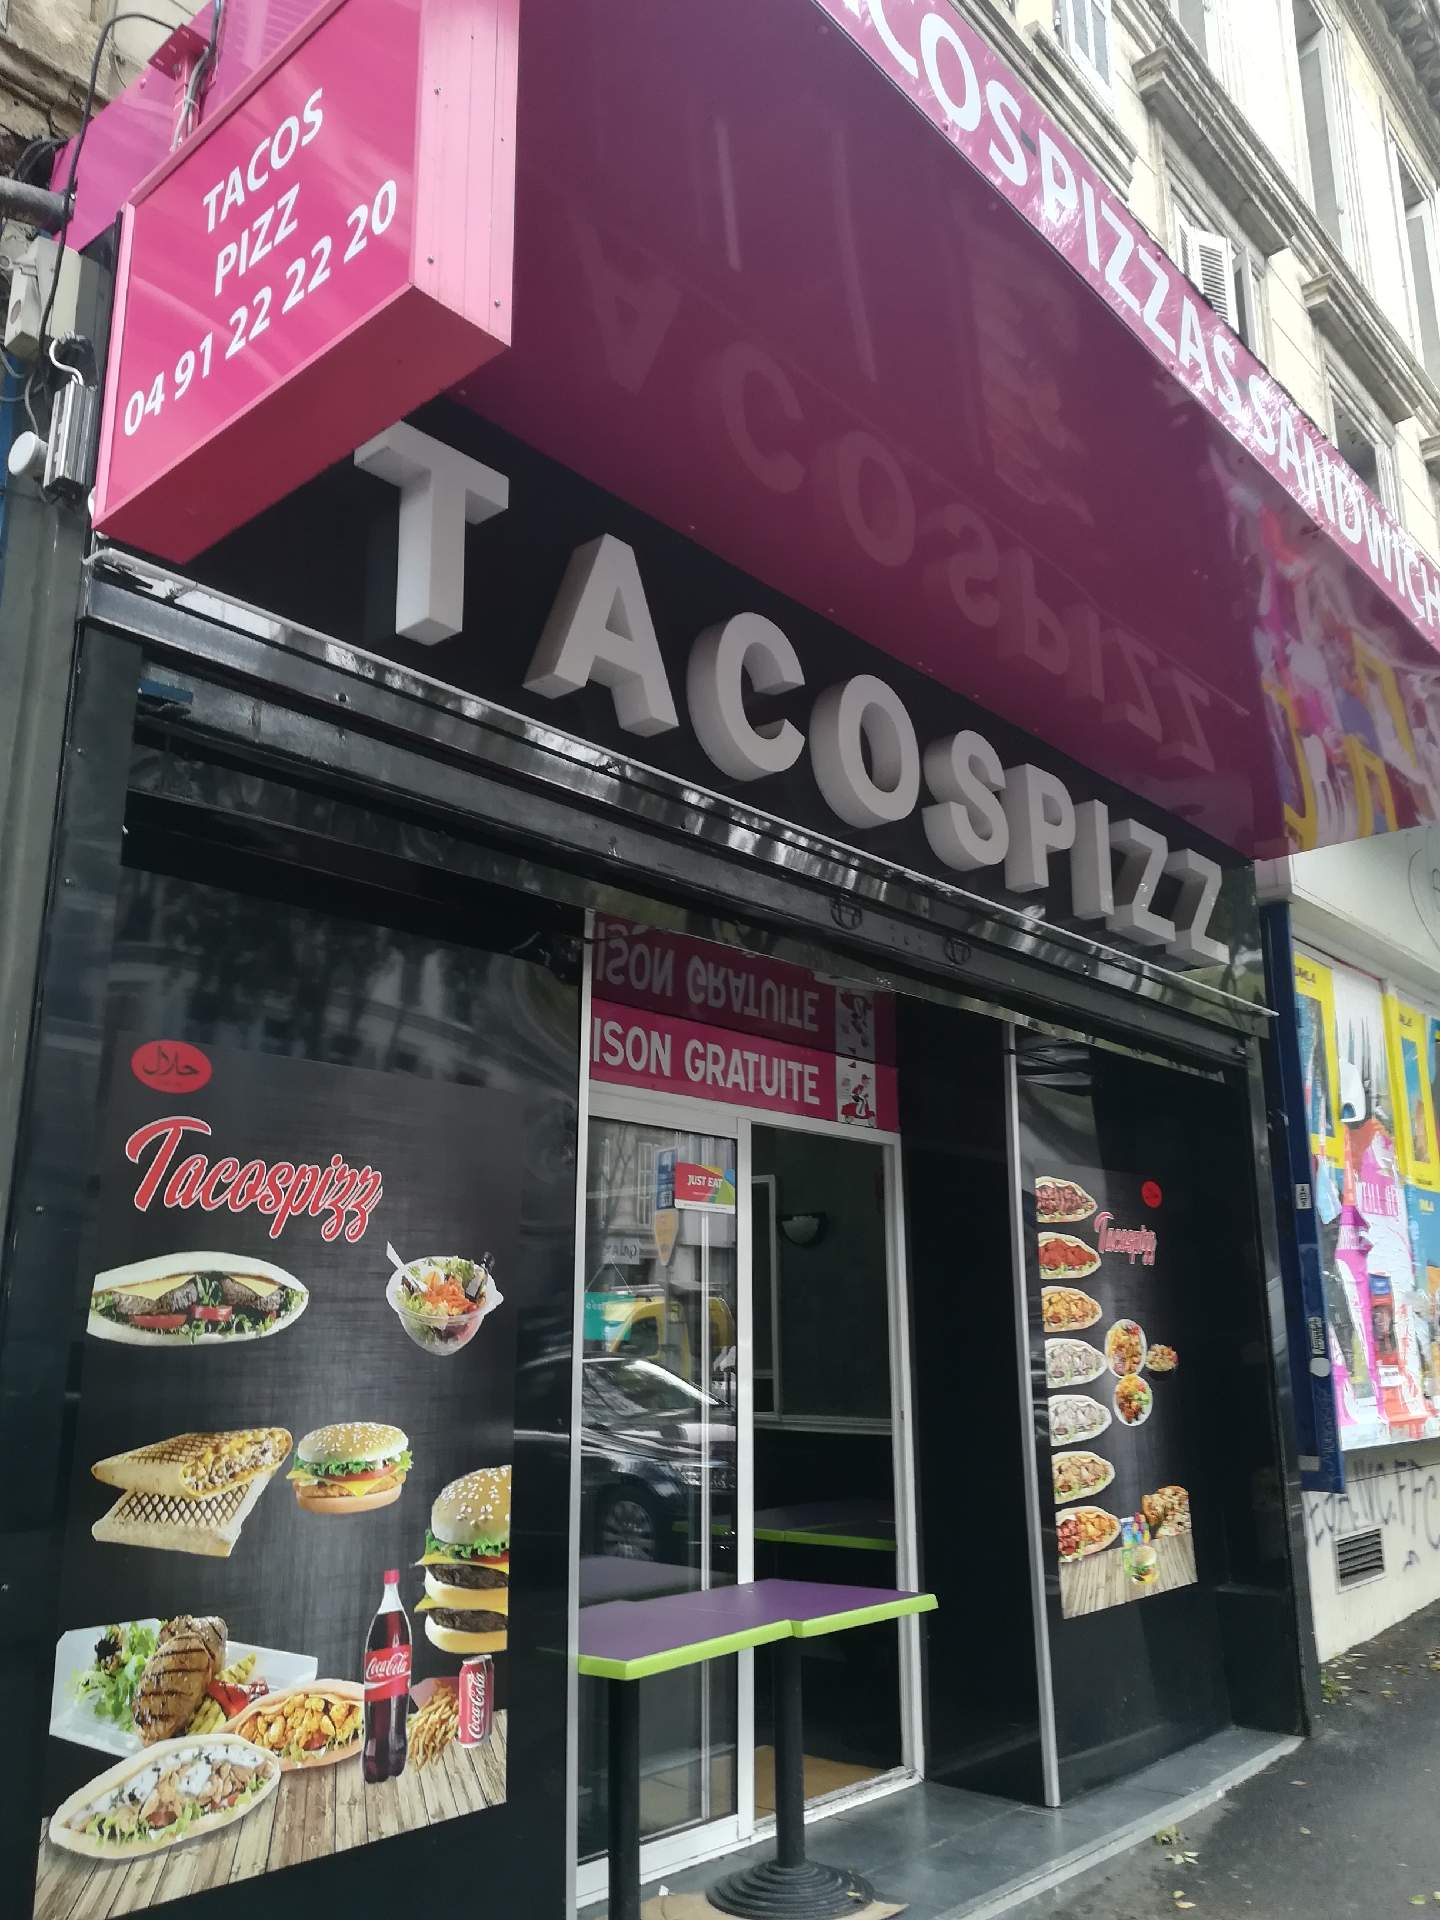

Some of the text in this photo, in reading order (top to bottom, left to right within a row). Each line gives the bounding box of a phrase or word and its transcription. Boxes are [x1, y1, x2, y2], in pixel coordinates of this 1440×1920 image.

[202, 87, 324, 235] TACOS
[845, 0, 1028, 187] COS
[124, 179, 398, 437] 04 91 22 22 20
[214, 182, 301, 297] PIZZ
[353, 420, 1230, 967] TACOSPIZZ
[591, 1017, 821, 1106] ISON GRATUITE
[125, 1115, 384, 1243] Tacospizz
[687, 1173, 723, 1189] JUST EAT
